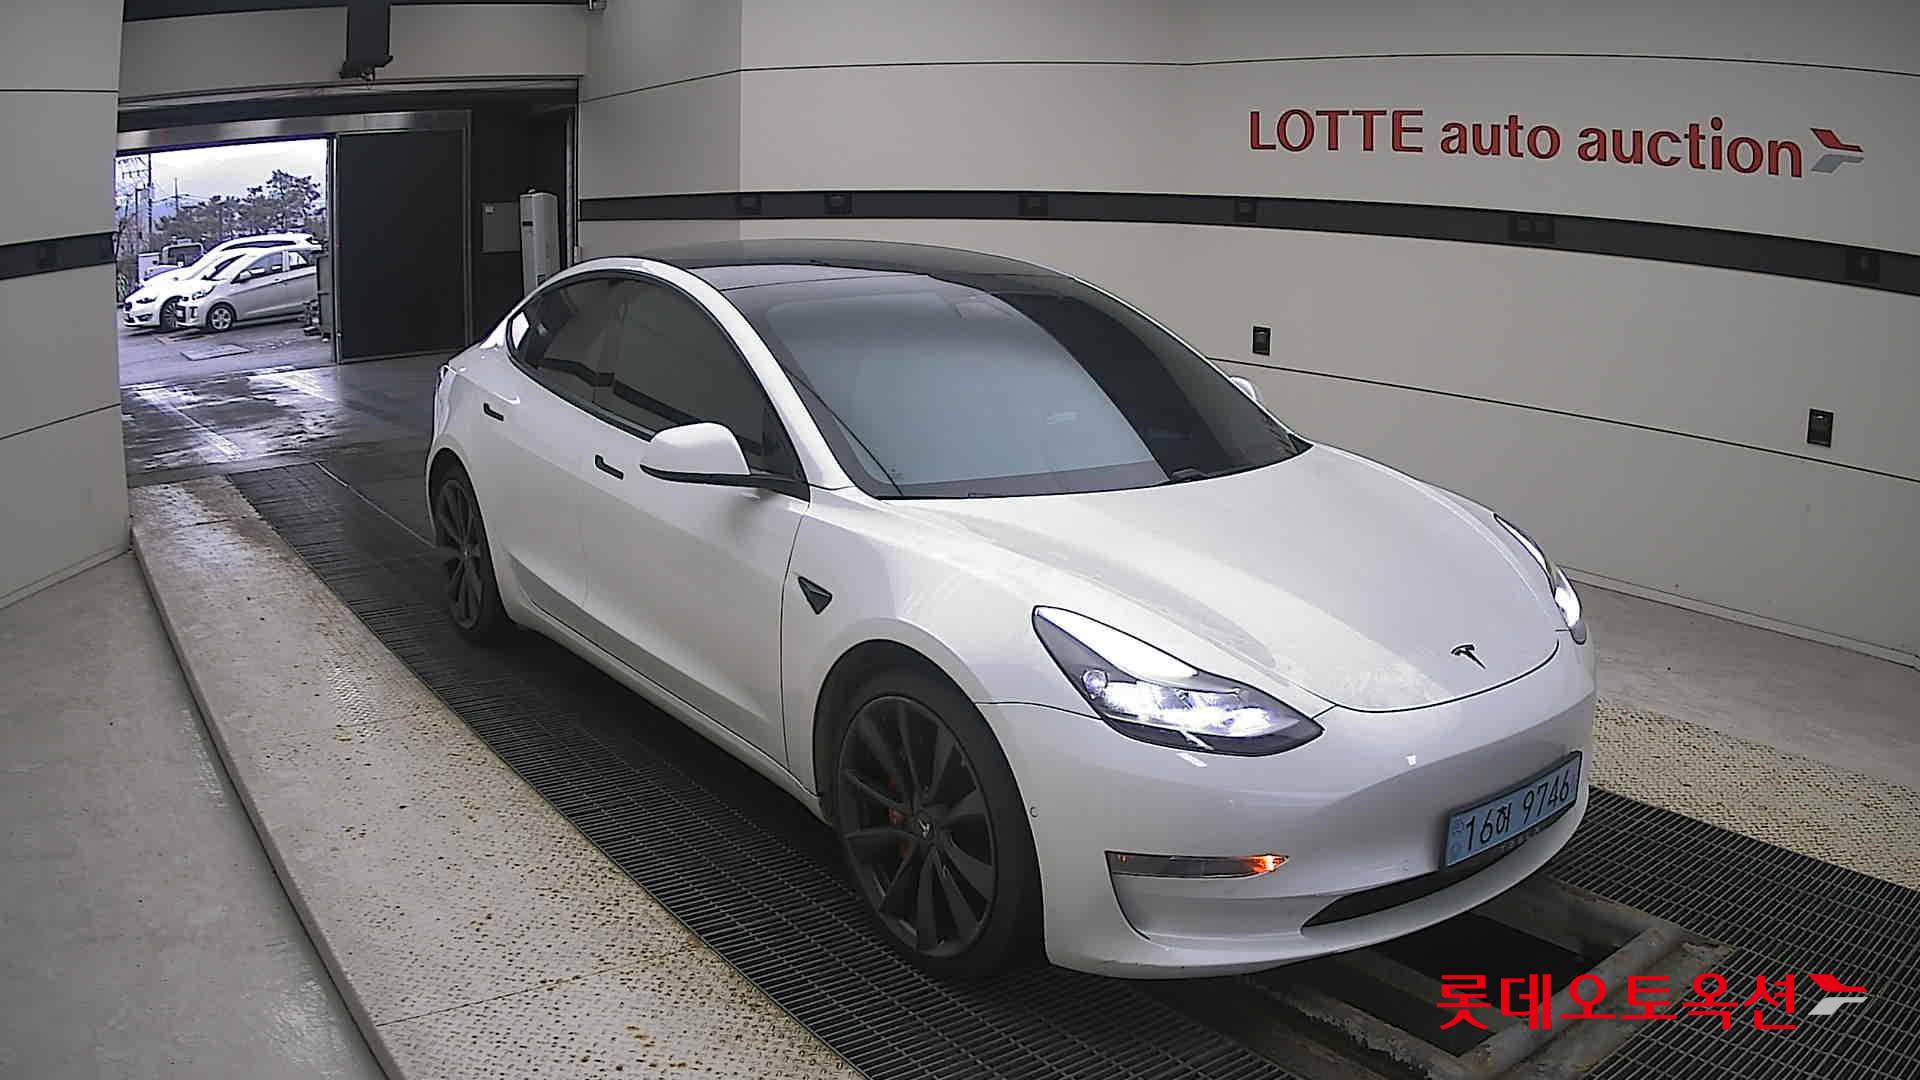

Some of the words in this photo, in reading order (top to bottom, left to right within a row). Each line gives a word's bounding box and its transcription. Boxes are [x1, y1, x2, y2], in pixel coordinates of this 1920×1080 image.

[1249, 109, 1424, 153] LOTTE
[1440, 114, 1561, 160] auto
[1577, 116, 1803, 178] auction
[1523, 770, 1569, 824] 9746
